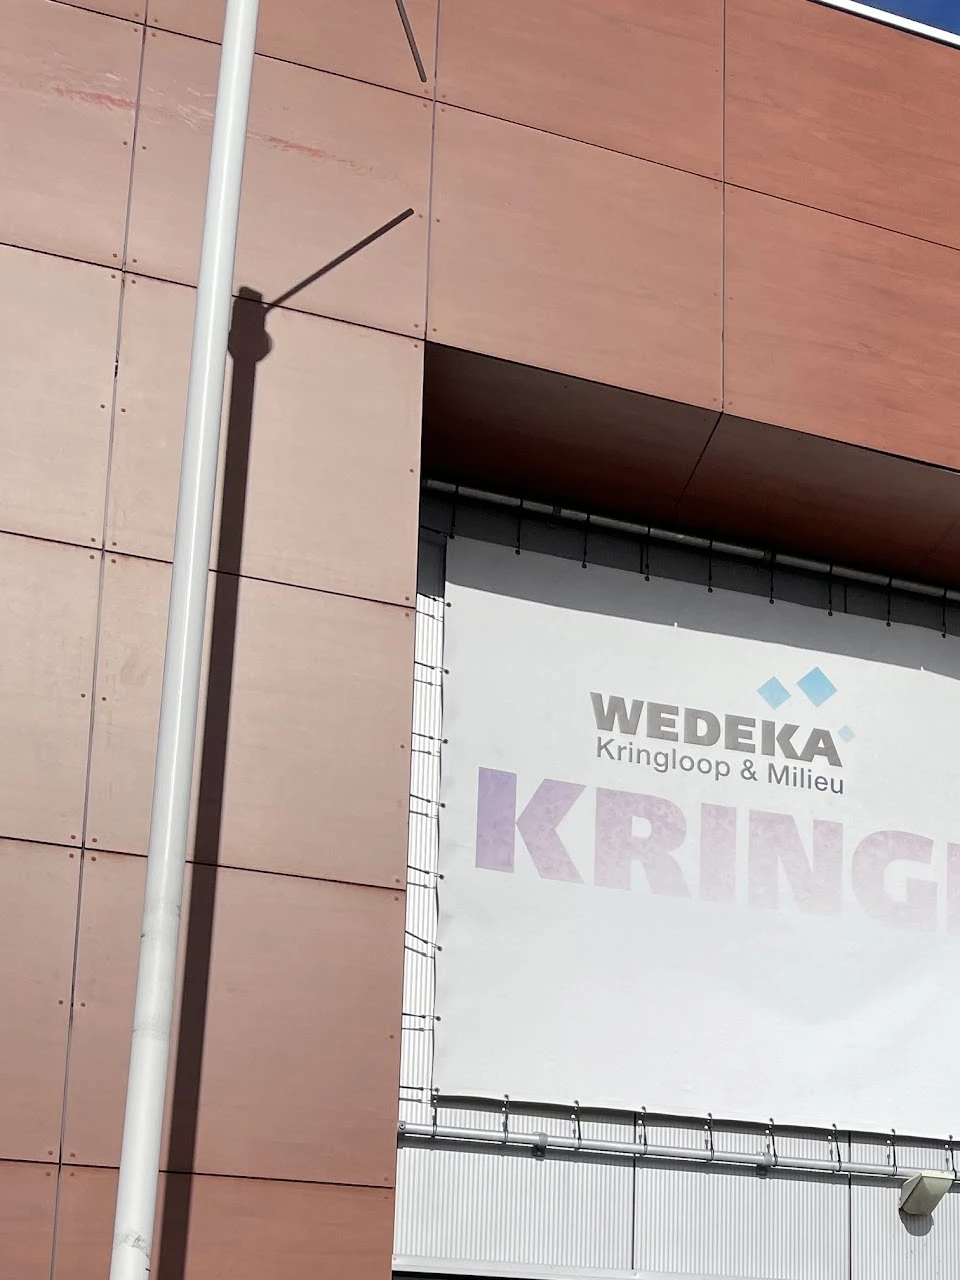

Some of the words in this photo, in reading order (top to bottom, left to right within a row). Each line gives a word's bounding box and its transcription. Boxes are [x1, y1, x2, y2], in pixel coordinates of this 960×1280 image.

[590, 691, 843, 768] WEDEKA
[596, 736, 731, 781] Kringloop
[740, 758, 758, 782] &
[768, 762, 844, 795] Milieu
